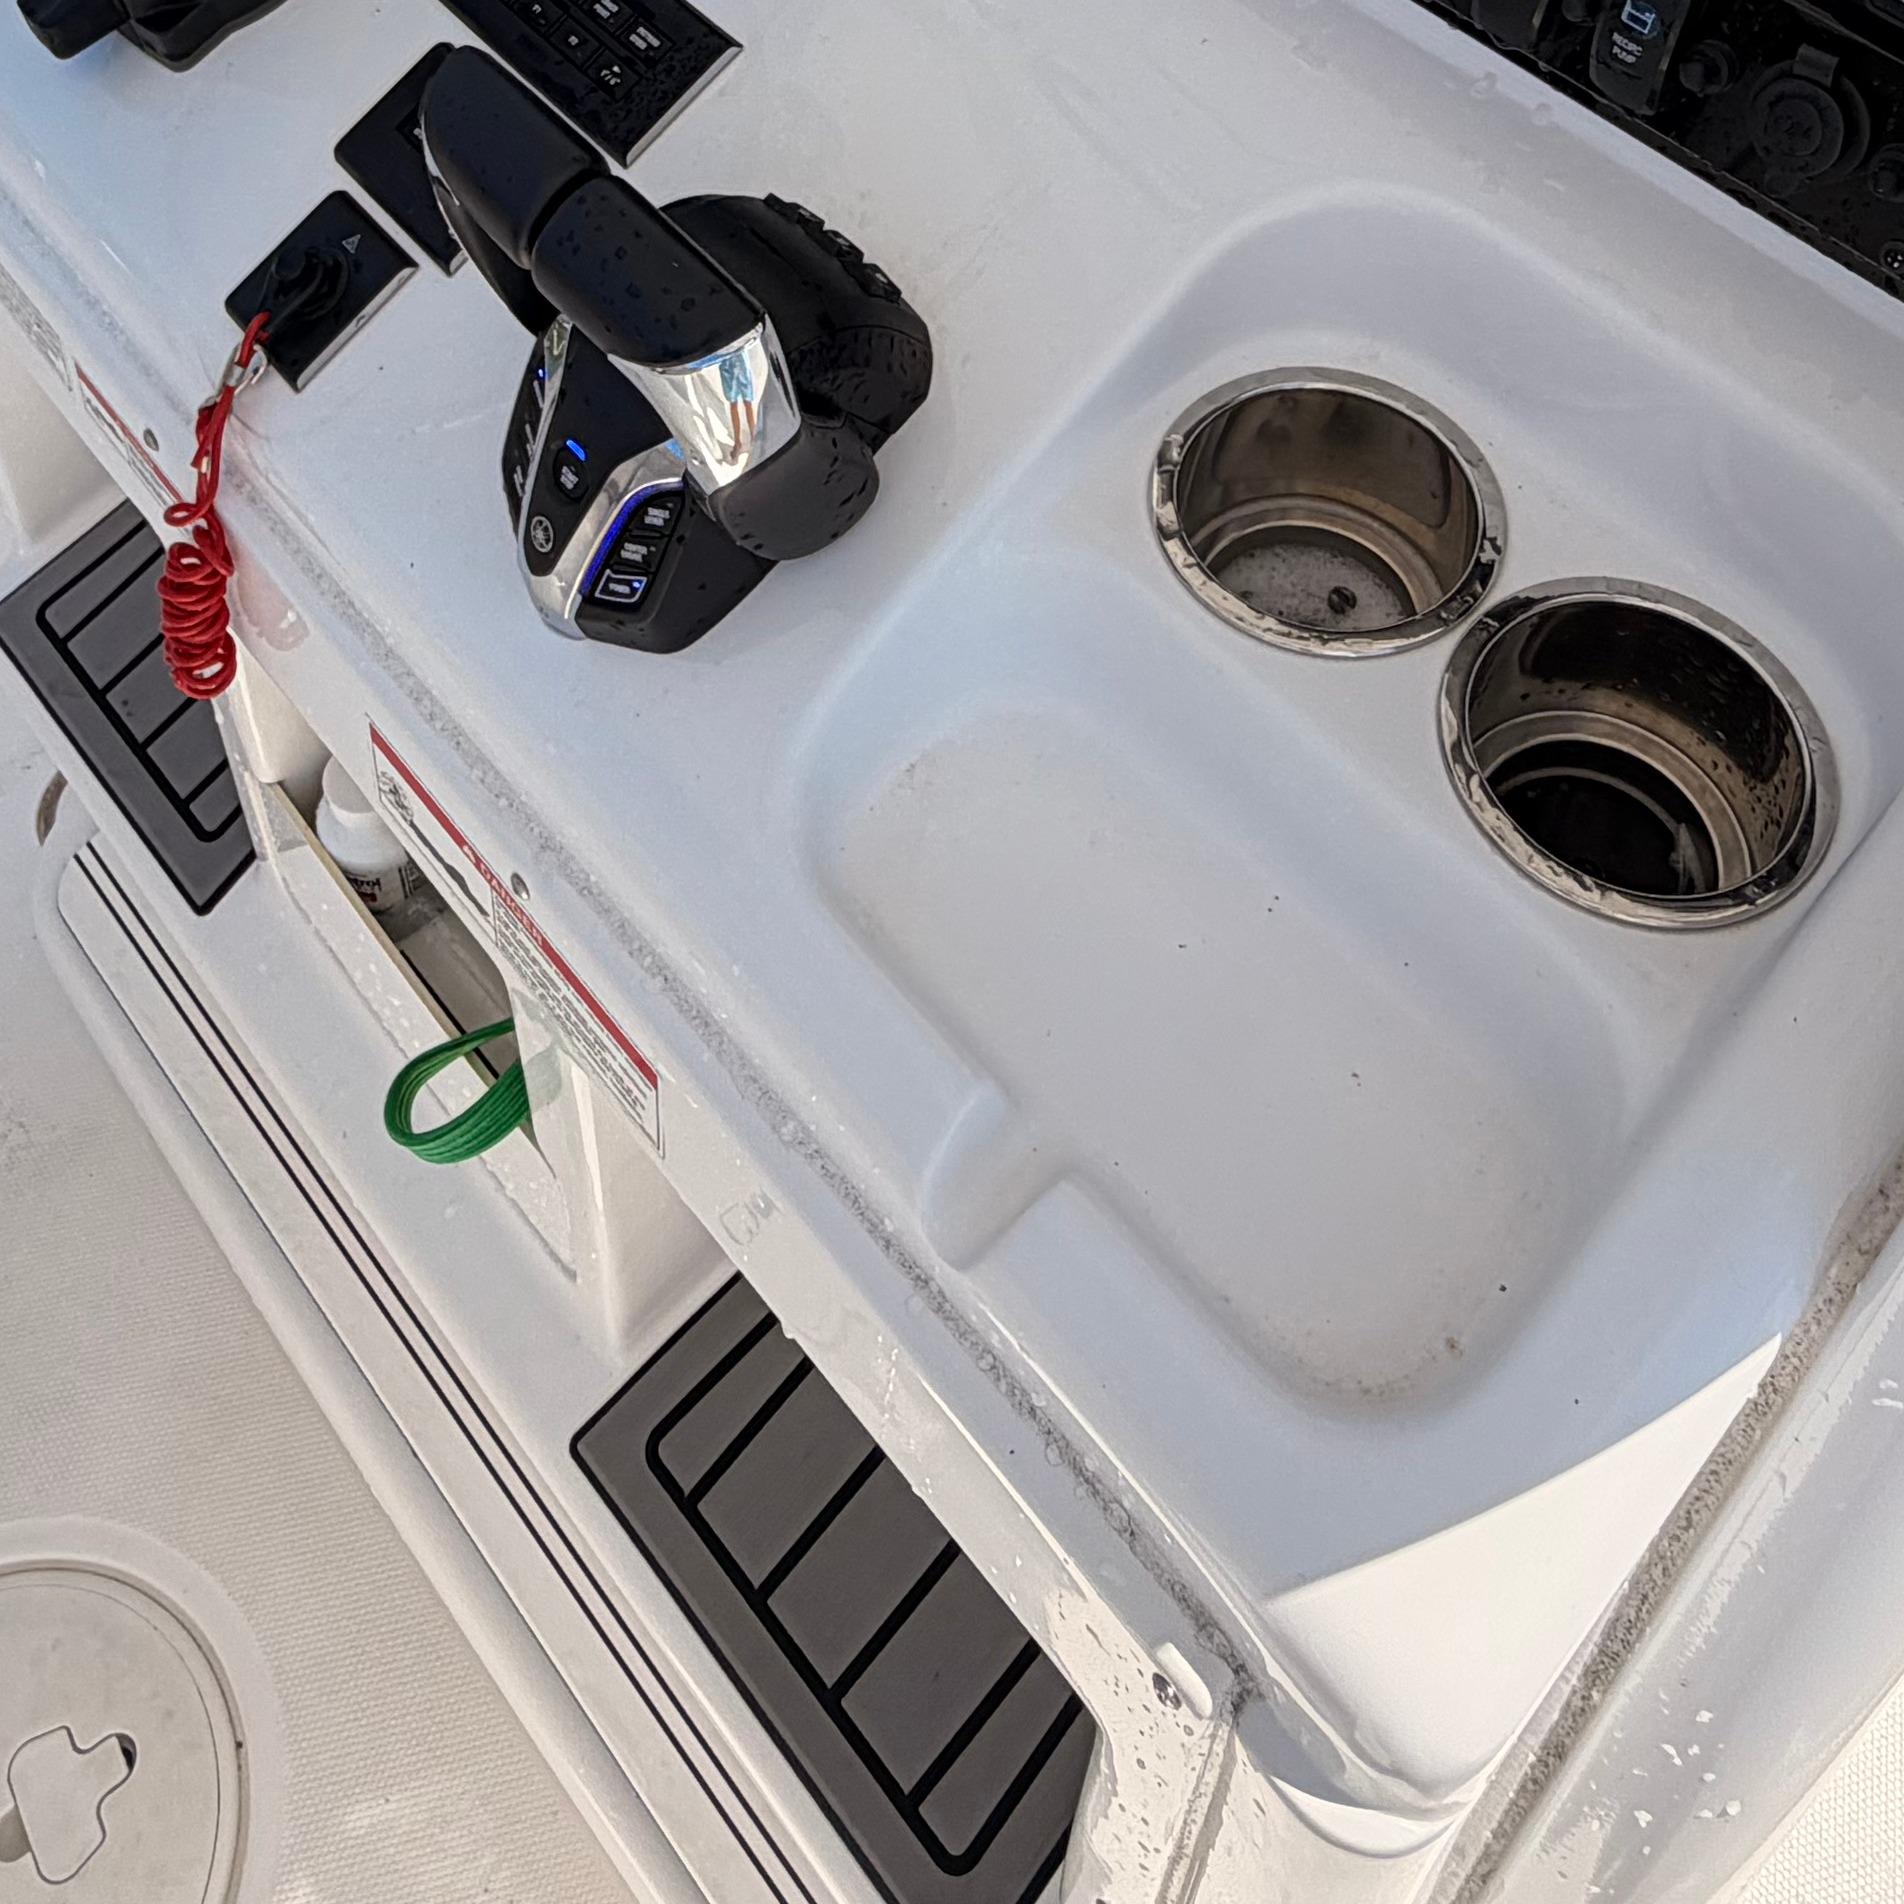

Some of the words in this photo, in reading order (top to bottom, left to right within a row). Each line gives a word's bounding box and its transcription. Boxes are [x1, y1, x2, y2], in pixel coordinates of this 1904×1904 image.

[1611, 31, 1644, 57] RECIRC
[1611, 45, 1637, 64] PUMP
[479, 861, 544, 946] DANGER
